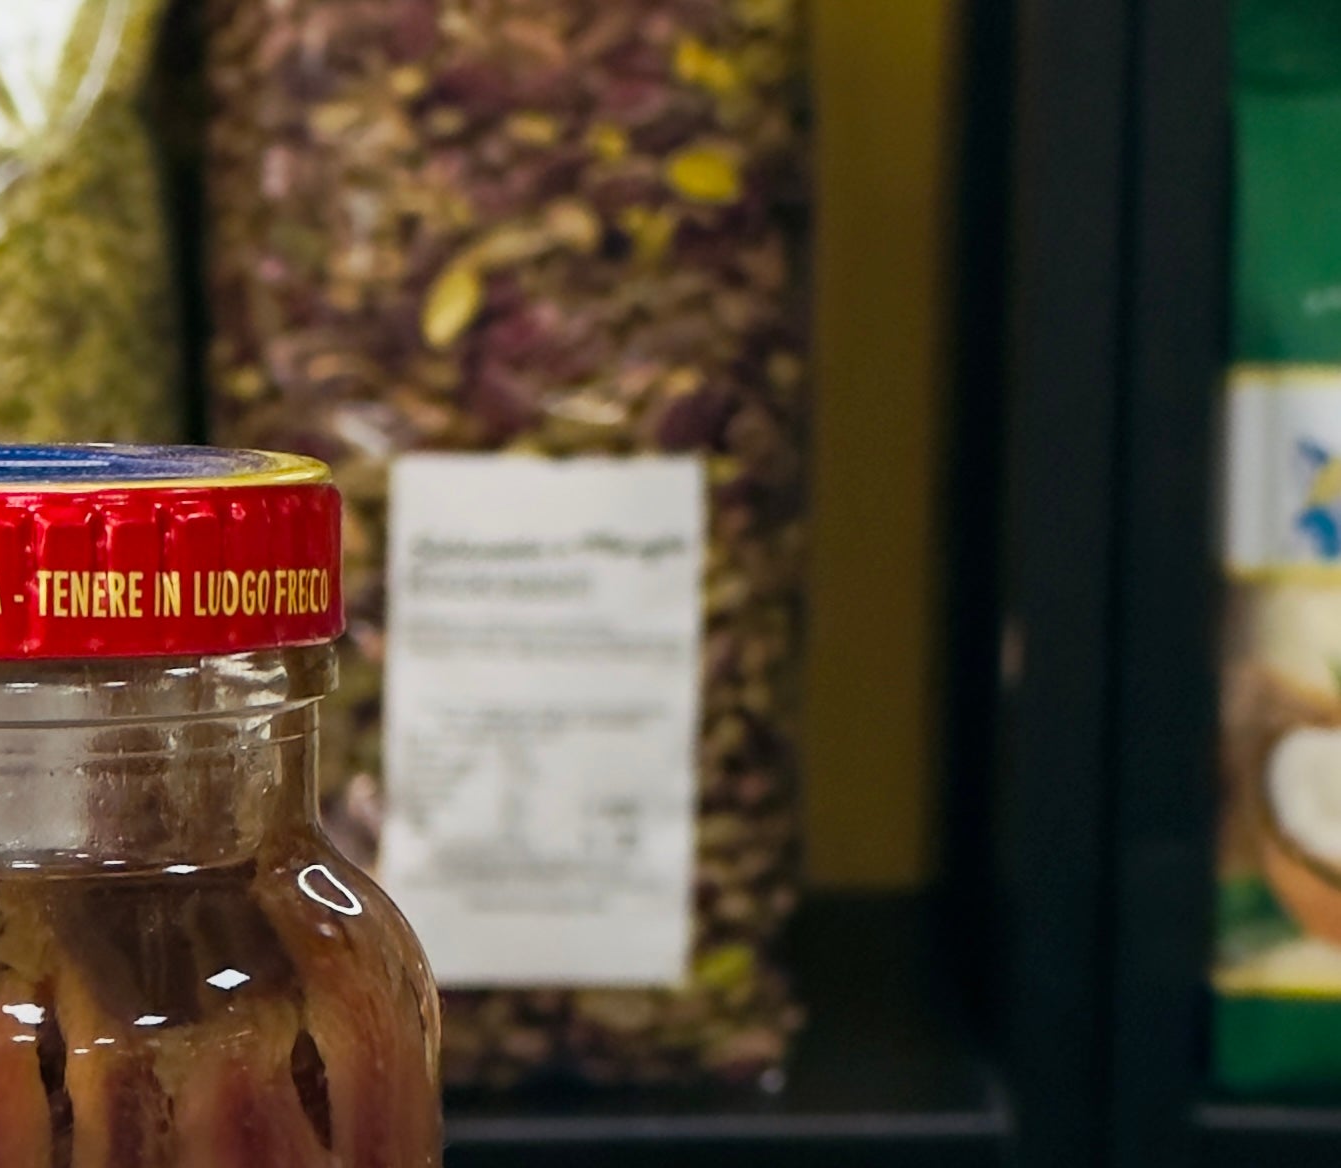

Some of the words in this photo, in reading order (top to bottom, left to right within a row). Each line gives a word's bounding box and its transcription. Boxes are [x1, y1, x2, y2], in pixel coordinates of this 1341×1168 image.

[37, 570, 144, 618] TENERE
[154, 571, 181, 618] IN
[193, 570, 271, 617] LUOGO
